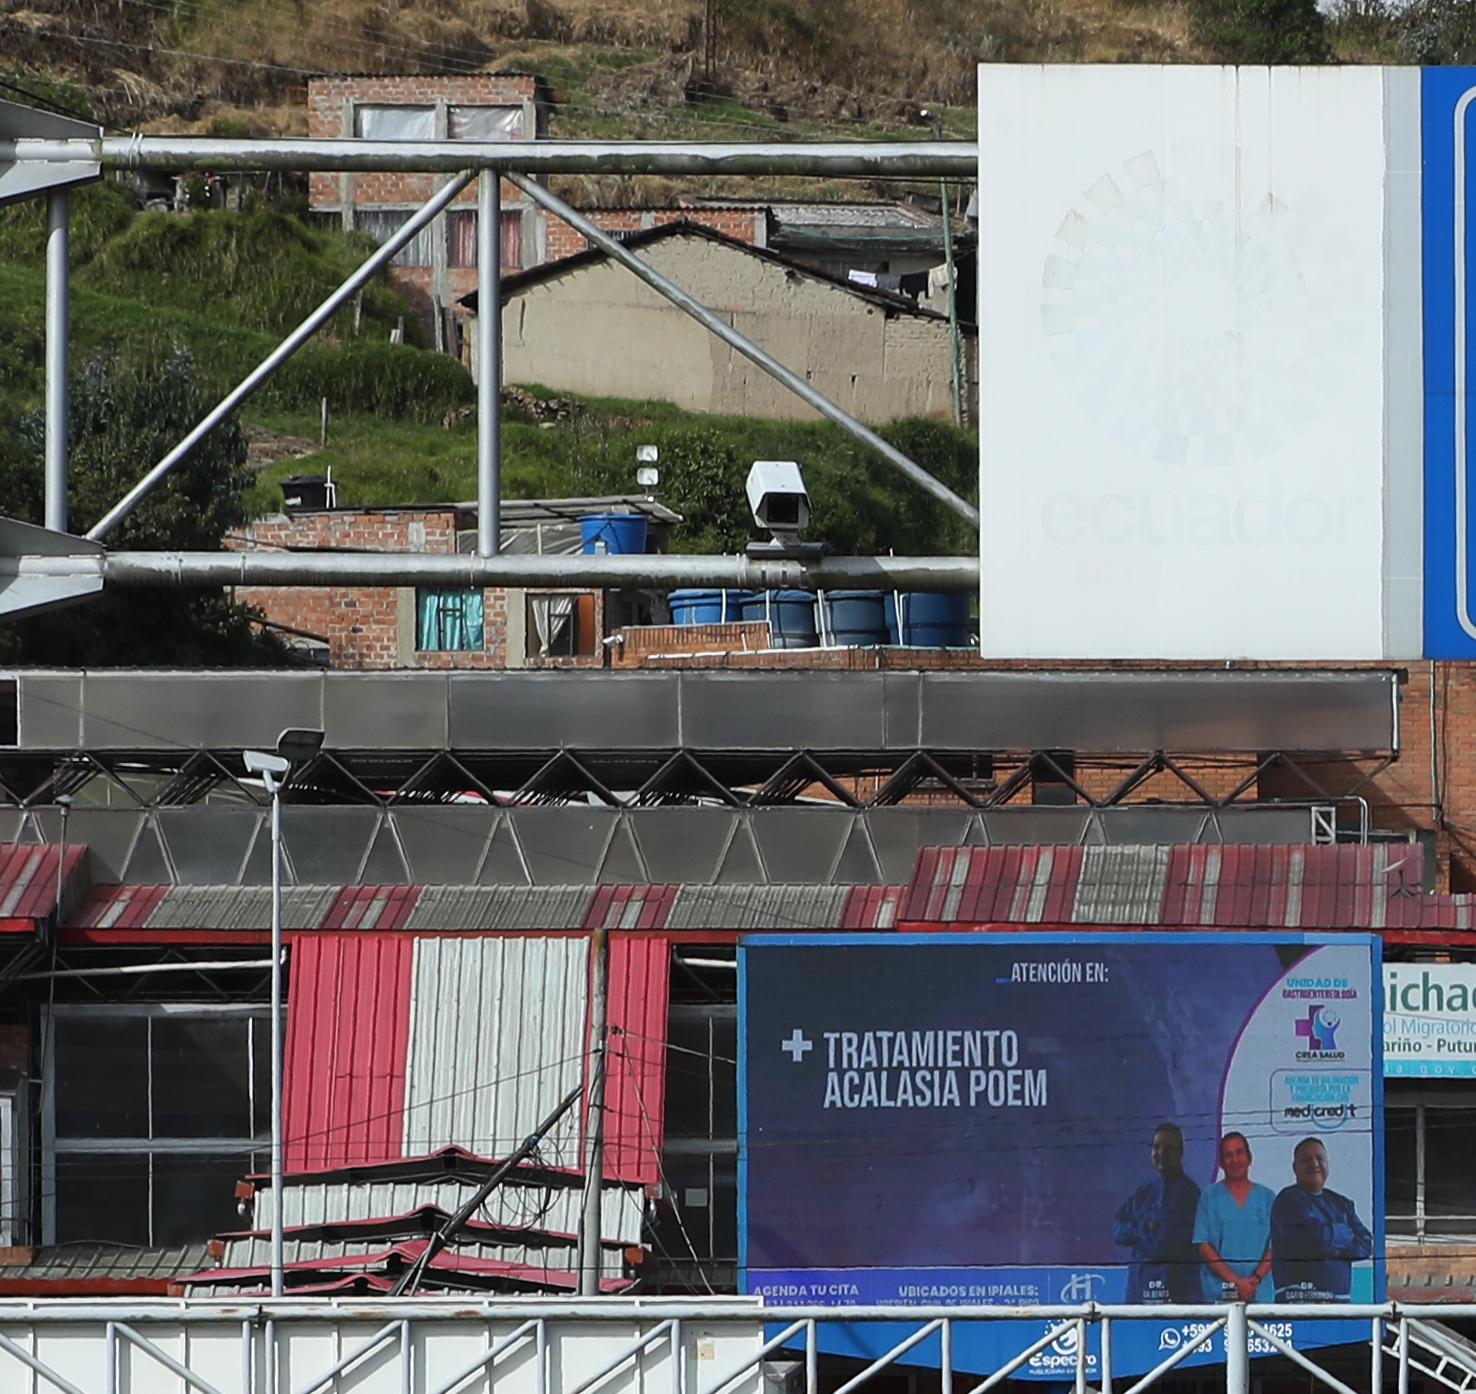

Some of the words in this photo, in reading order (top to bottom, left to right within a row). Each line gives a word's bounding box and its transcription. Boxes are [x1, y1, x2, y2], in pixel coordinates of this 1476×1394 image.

[1011, 961, 1082, 983] ATENCIÓN
[1087, 962, 1109, 982] EN:
[823, 1030, 1019, 1069] TRATAMIENTO
[1384, 1038, 1422, 1053] ariño
[823, 1070, 960, 1108] ACALASIA
[970, 1069, 1048, 1107] POEM
[754, 1285, 808, 1297] AGENDA
[810, 1285, 827, 1296] TU
[829, 1284, 860, 1296] CITA
[899, 1286, 967, 1298] UBICADOS
[969, 1286, 986, 1297] EN
[988, 1285, 1040, 1297] IPIALES:
[1029, 1352, 1097, 1369] Especo
